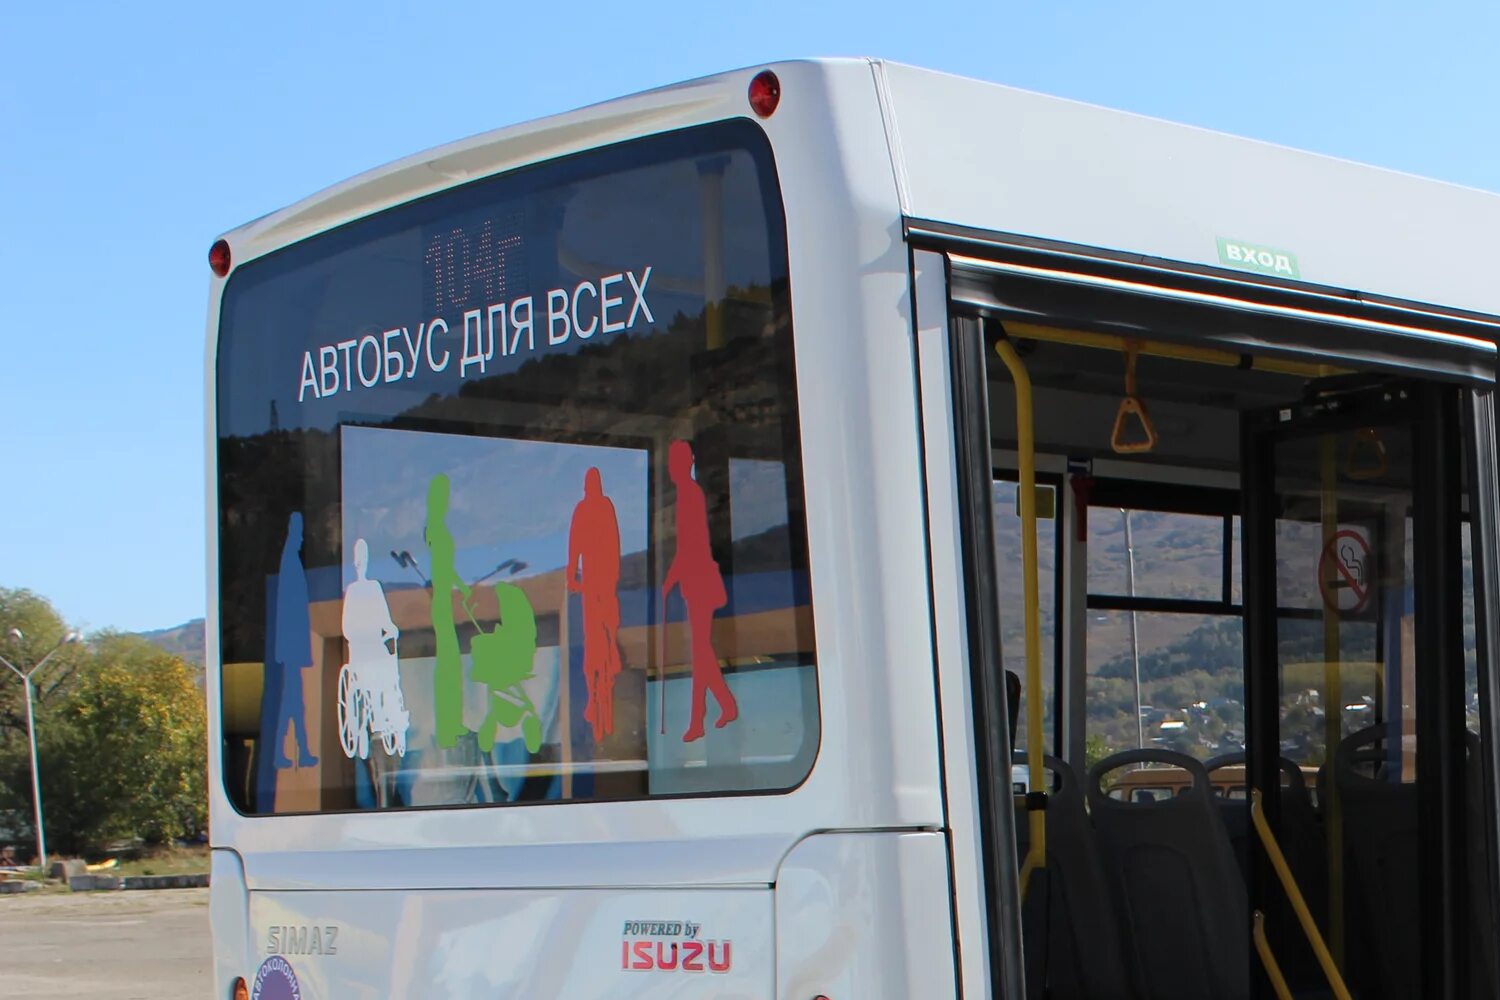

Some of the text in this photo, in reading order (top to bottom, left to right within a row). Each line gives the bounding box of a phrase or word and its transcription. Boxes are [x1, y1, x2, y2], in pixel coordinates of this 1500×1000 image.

[1226, 243, 1293, 275] ВХОД
[297, 266, 654, 402] АВТОБУС ДЛЯ ВСЕХ
[266, 925, 338, 955] SIMAZ
[623, 921, 700, 939] POWERED by
[621, 940, 731, 972] ISUZU
